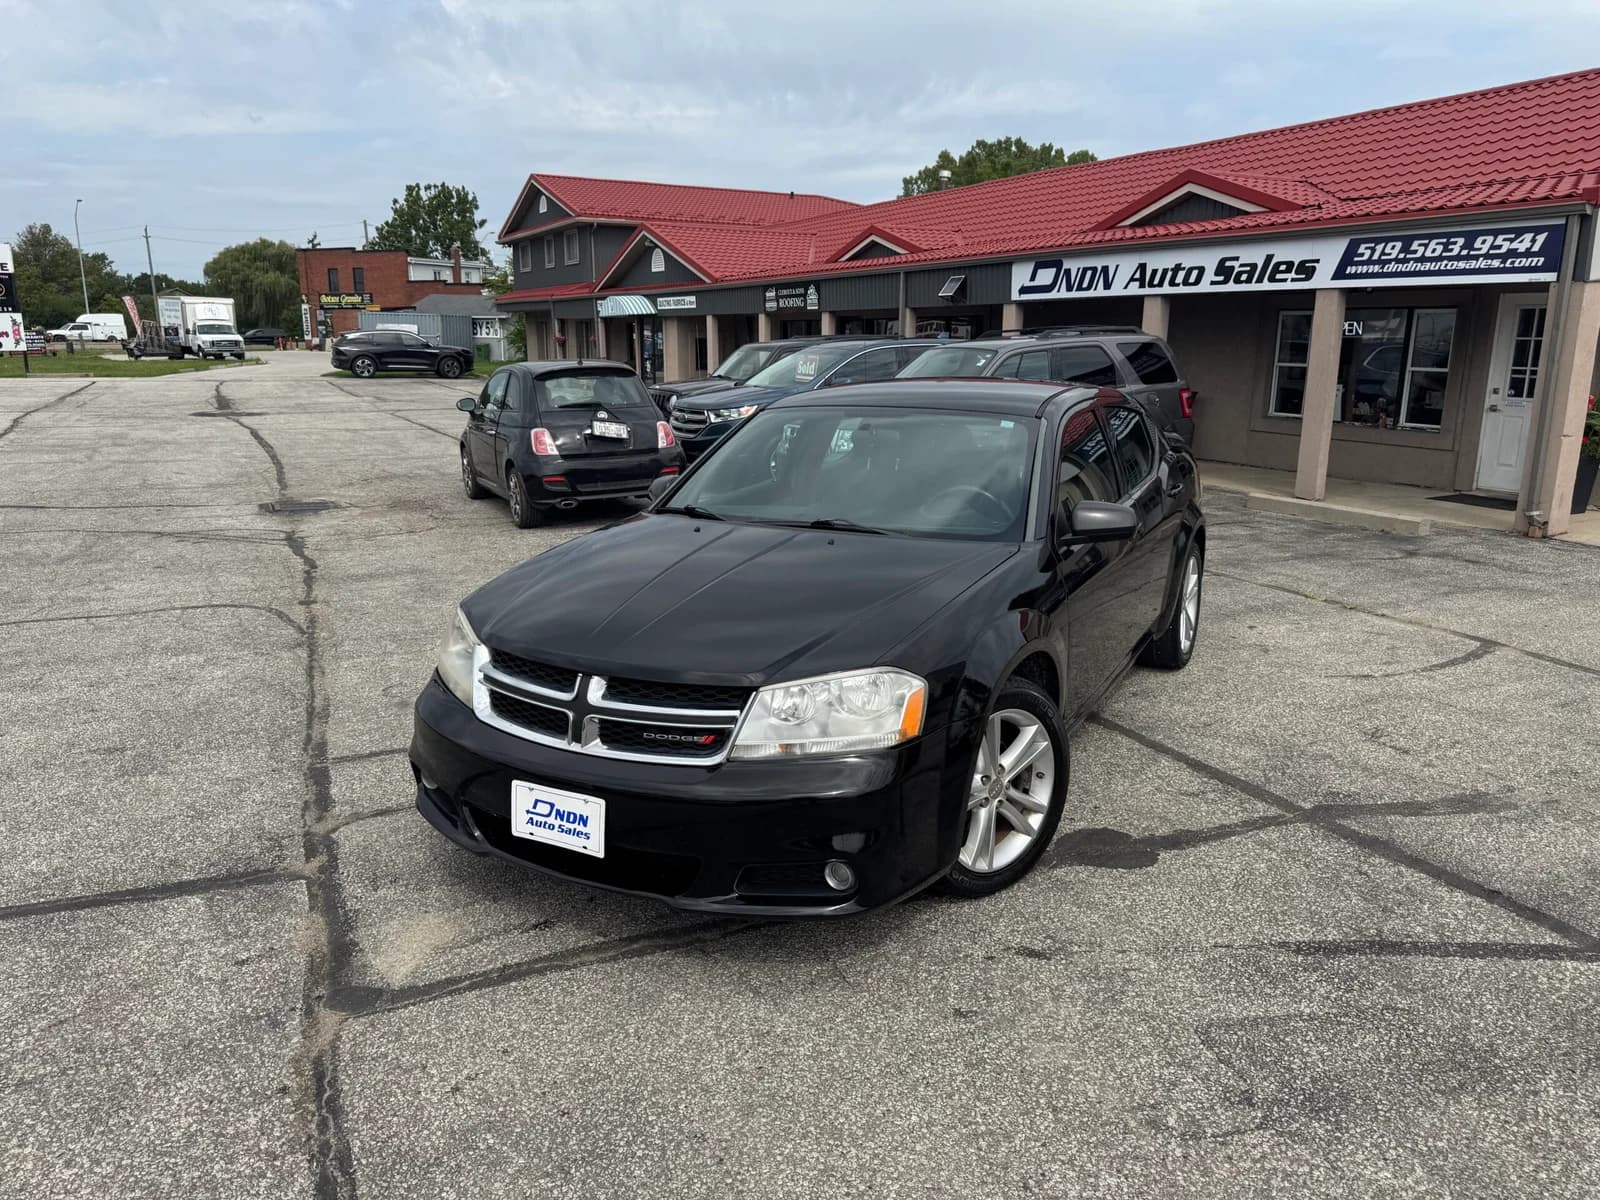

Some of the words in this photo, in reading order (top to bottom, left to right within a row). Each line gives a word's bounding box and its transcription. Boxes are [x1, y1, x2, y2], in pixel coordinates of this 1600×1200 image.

[1353, 231, 1549, 262] 519.563.9541
[1018, 258, 1120, 297] DNDN
[1123, 261, 1206, 290] Auto
[1209, 253, 1321, 286] Sales
[1345, 256, 1545, 274] www.dndnautosales.com
[779, 297, 804, 308] ROOFING
[797, 360, 816, 375] Sold
[643, 732, 705, 743] DODGE
[525, 798, 589, 828] DNDN
[526, 816, 556, 831] Auto
[557, 823, 592, 841] Sales
